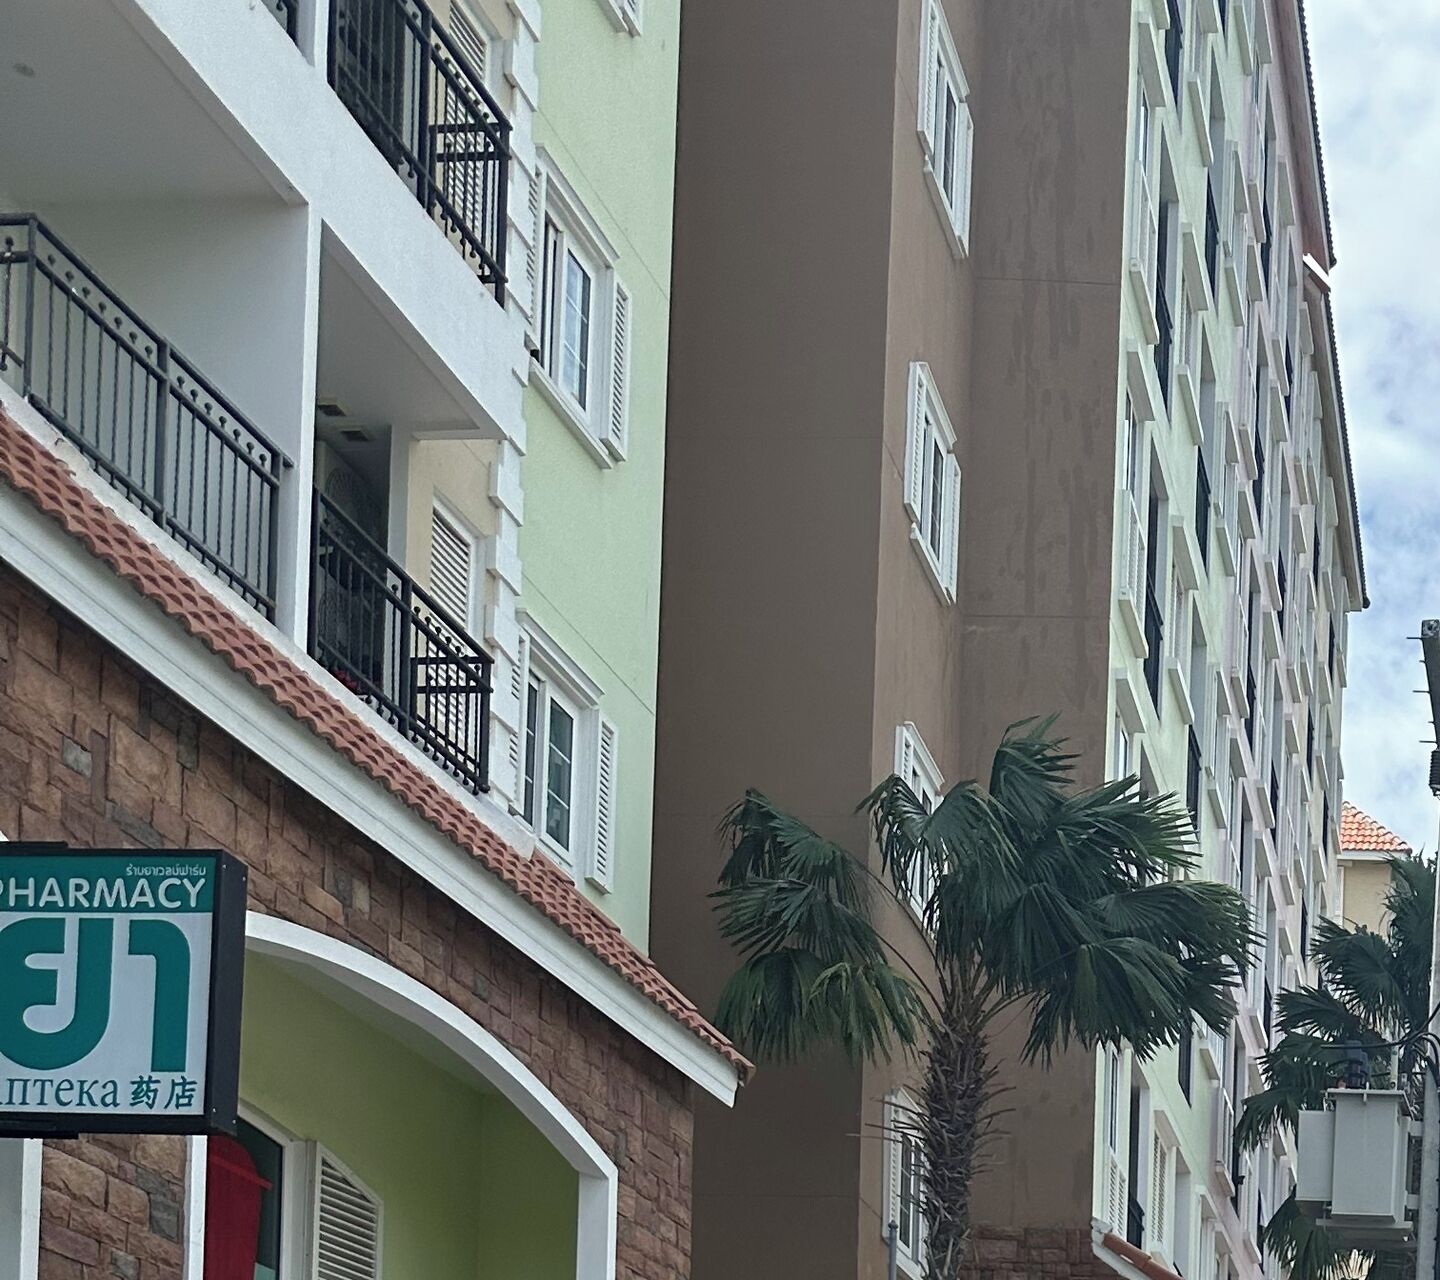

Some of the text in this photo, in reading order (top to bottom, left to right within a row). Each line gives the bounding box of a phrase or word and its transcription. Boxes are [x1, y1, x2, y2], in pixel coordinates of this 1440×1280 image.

[0, 877, 206, 909] HARMACY
[0, 1078, 121, 1107] птека
[130, 1075, 198, 1110] 药店
